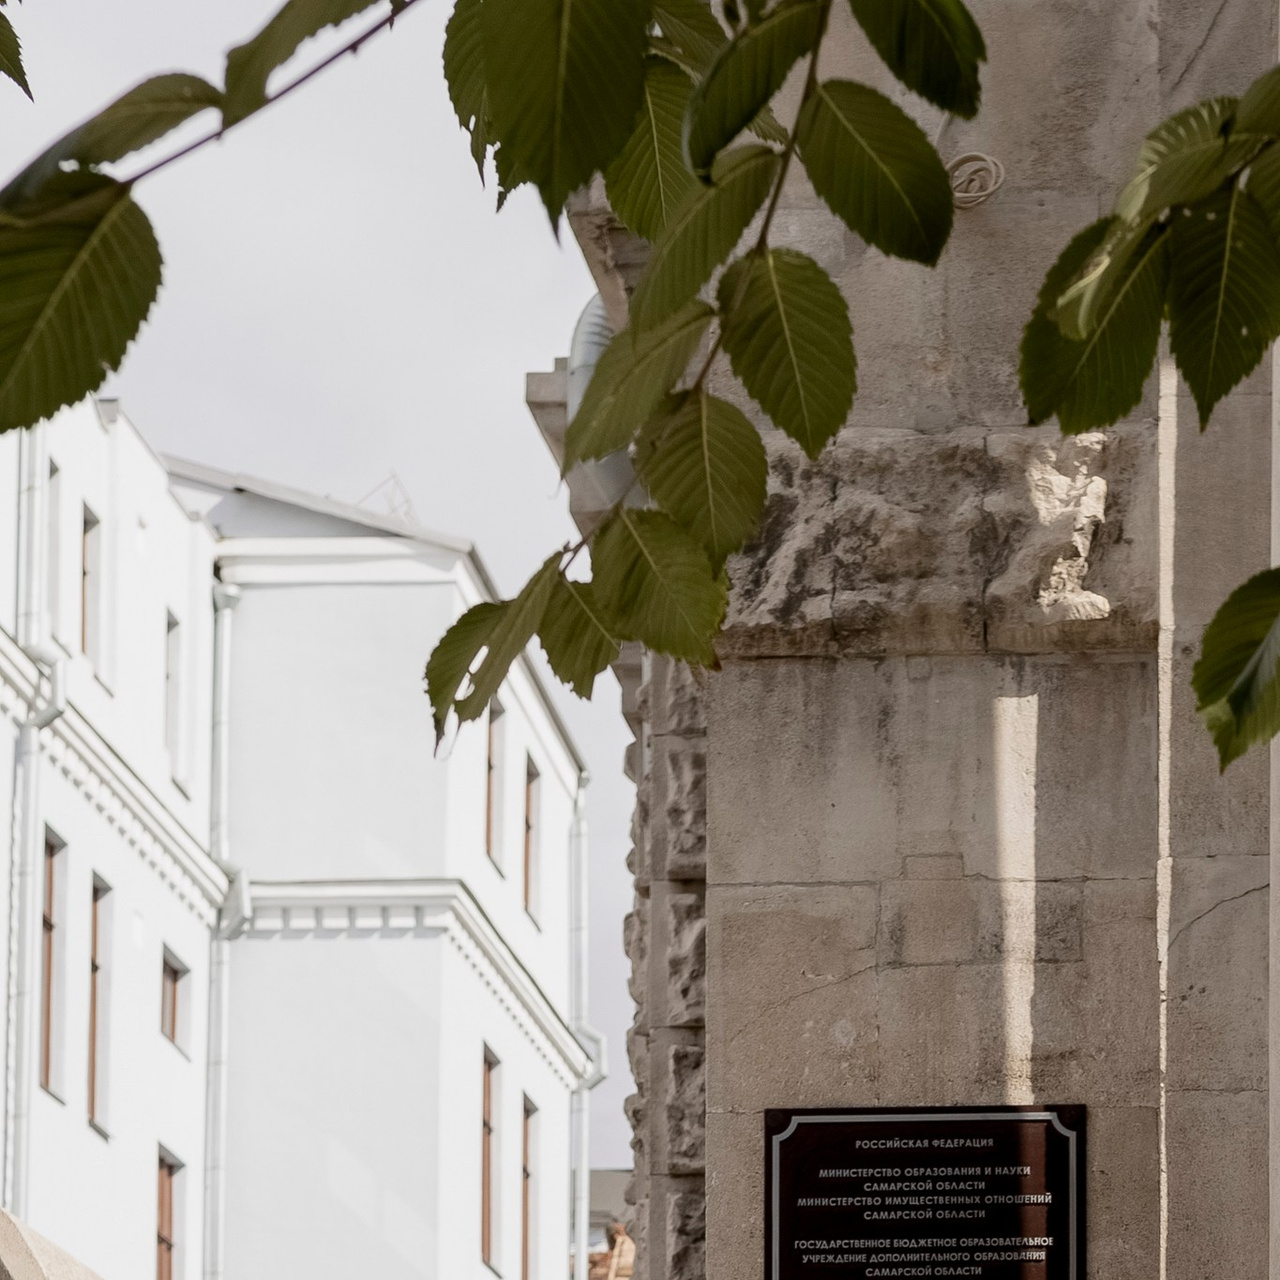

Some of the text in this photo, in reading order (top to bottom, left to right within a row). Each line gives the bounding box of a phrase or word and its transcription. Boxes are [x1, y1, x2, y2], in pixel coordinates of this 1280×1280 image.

[855, 1138, 994, 1148] РОССИЙСКАЯ ФЕДЕРАЦИЯ
[818, 1166, 1032, 1177] МИНИСТЕРСТВО ОБРАЗОВАНИЯ И НАУКИ
[863, 1180, 985, 1191] САМАРСКОЙ ОБЛАСТИ
[797, 1193, 1053, 1206] МИНИСТЕРСТВО ИМУЩЕСТВЕННЫХ ОТНОШЕНИЙ
[863, 1208, 933, 1219] САМАРСКОЙ
[794, 1237, 1054, 1249] ГОСУДАРСТВЕННОЕ БЮДЖЕТНОЕ ОБРАЗОВАТЕЛЬНОЕ
[802, 1249, 1047, 1263] УЧРЕЖДЕНИЕ ДОПОЛНИТЕЛЬНОГО ОБРАЗОВАНИЯ
[865, 1265, 982, 1276] САМАРСКОЙ ОБЛАСТИ
